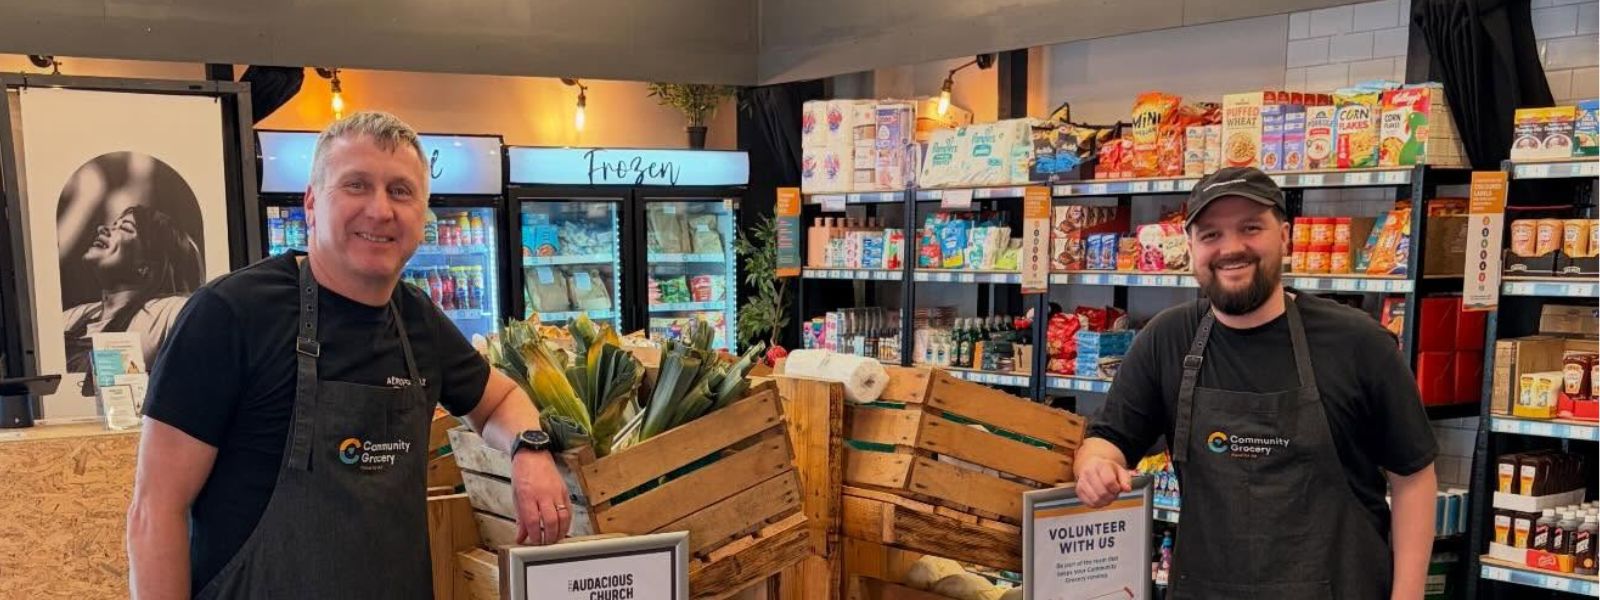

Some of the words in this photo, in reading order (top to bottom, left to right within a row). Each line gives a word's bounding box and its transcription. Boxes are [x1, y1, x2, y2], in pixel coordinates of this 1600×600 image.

[1227, 106, 1259, 117] PUFFED
[1340, 108, 1369, 121] CORN
[1384, 113, 1401, 122] CORN
[1227, 117, 1257, 126] WHEAT
[1340, 120, 1369, 131] FLAKES
[584, 150, 680, 187] Frozen
[363, 439, 410, 453] Community
[1230, 435, 1290, 448] Community
[1230, 444, 1271, 455] Grocery
[361, 452, 396, 465] Grocery
[1049, 520, 1126, 540] VOLUNTEER
[1060, 540, 1095, 554] WITH
[1099, 536, 1115, 549] US
[572, 573, 633, 592] AUDACIOUS
[589, 587, 634, 600] CHURCH
